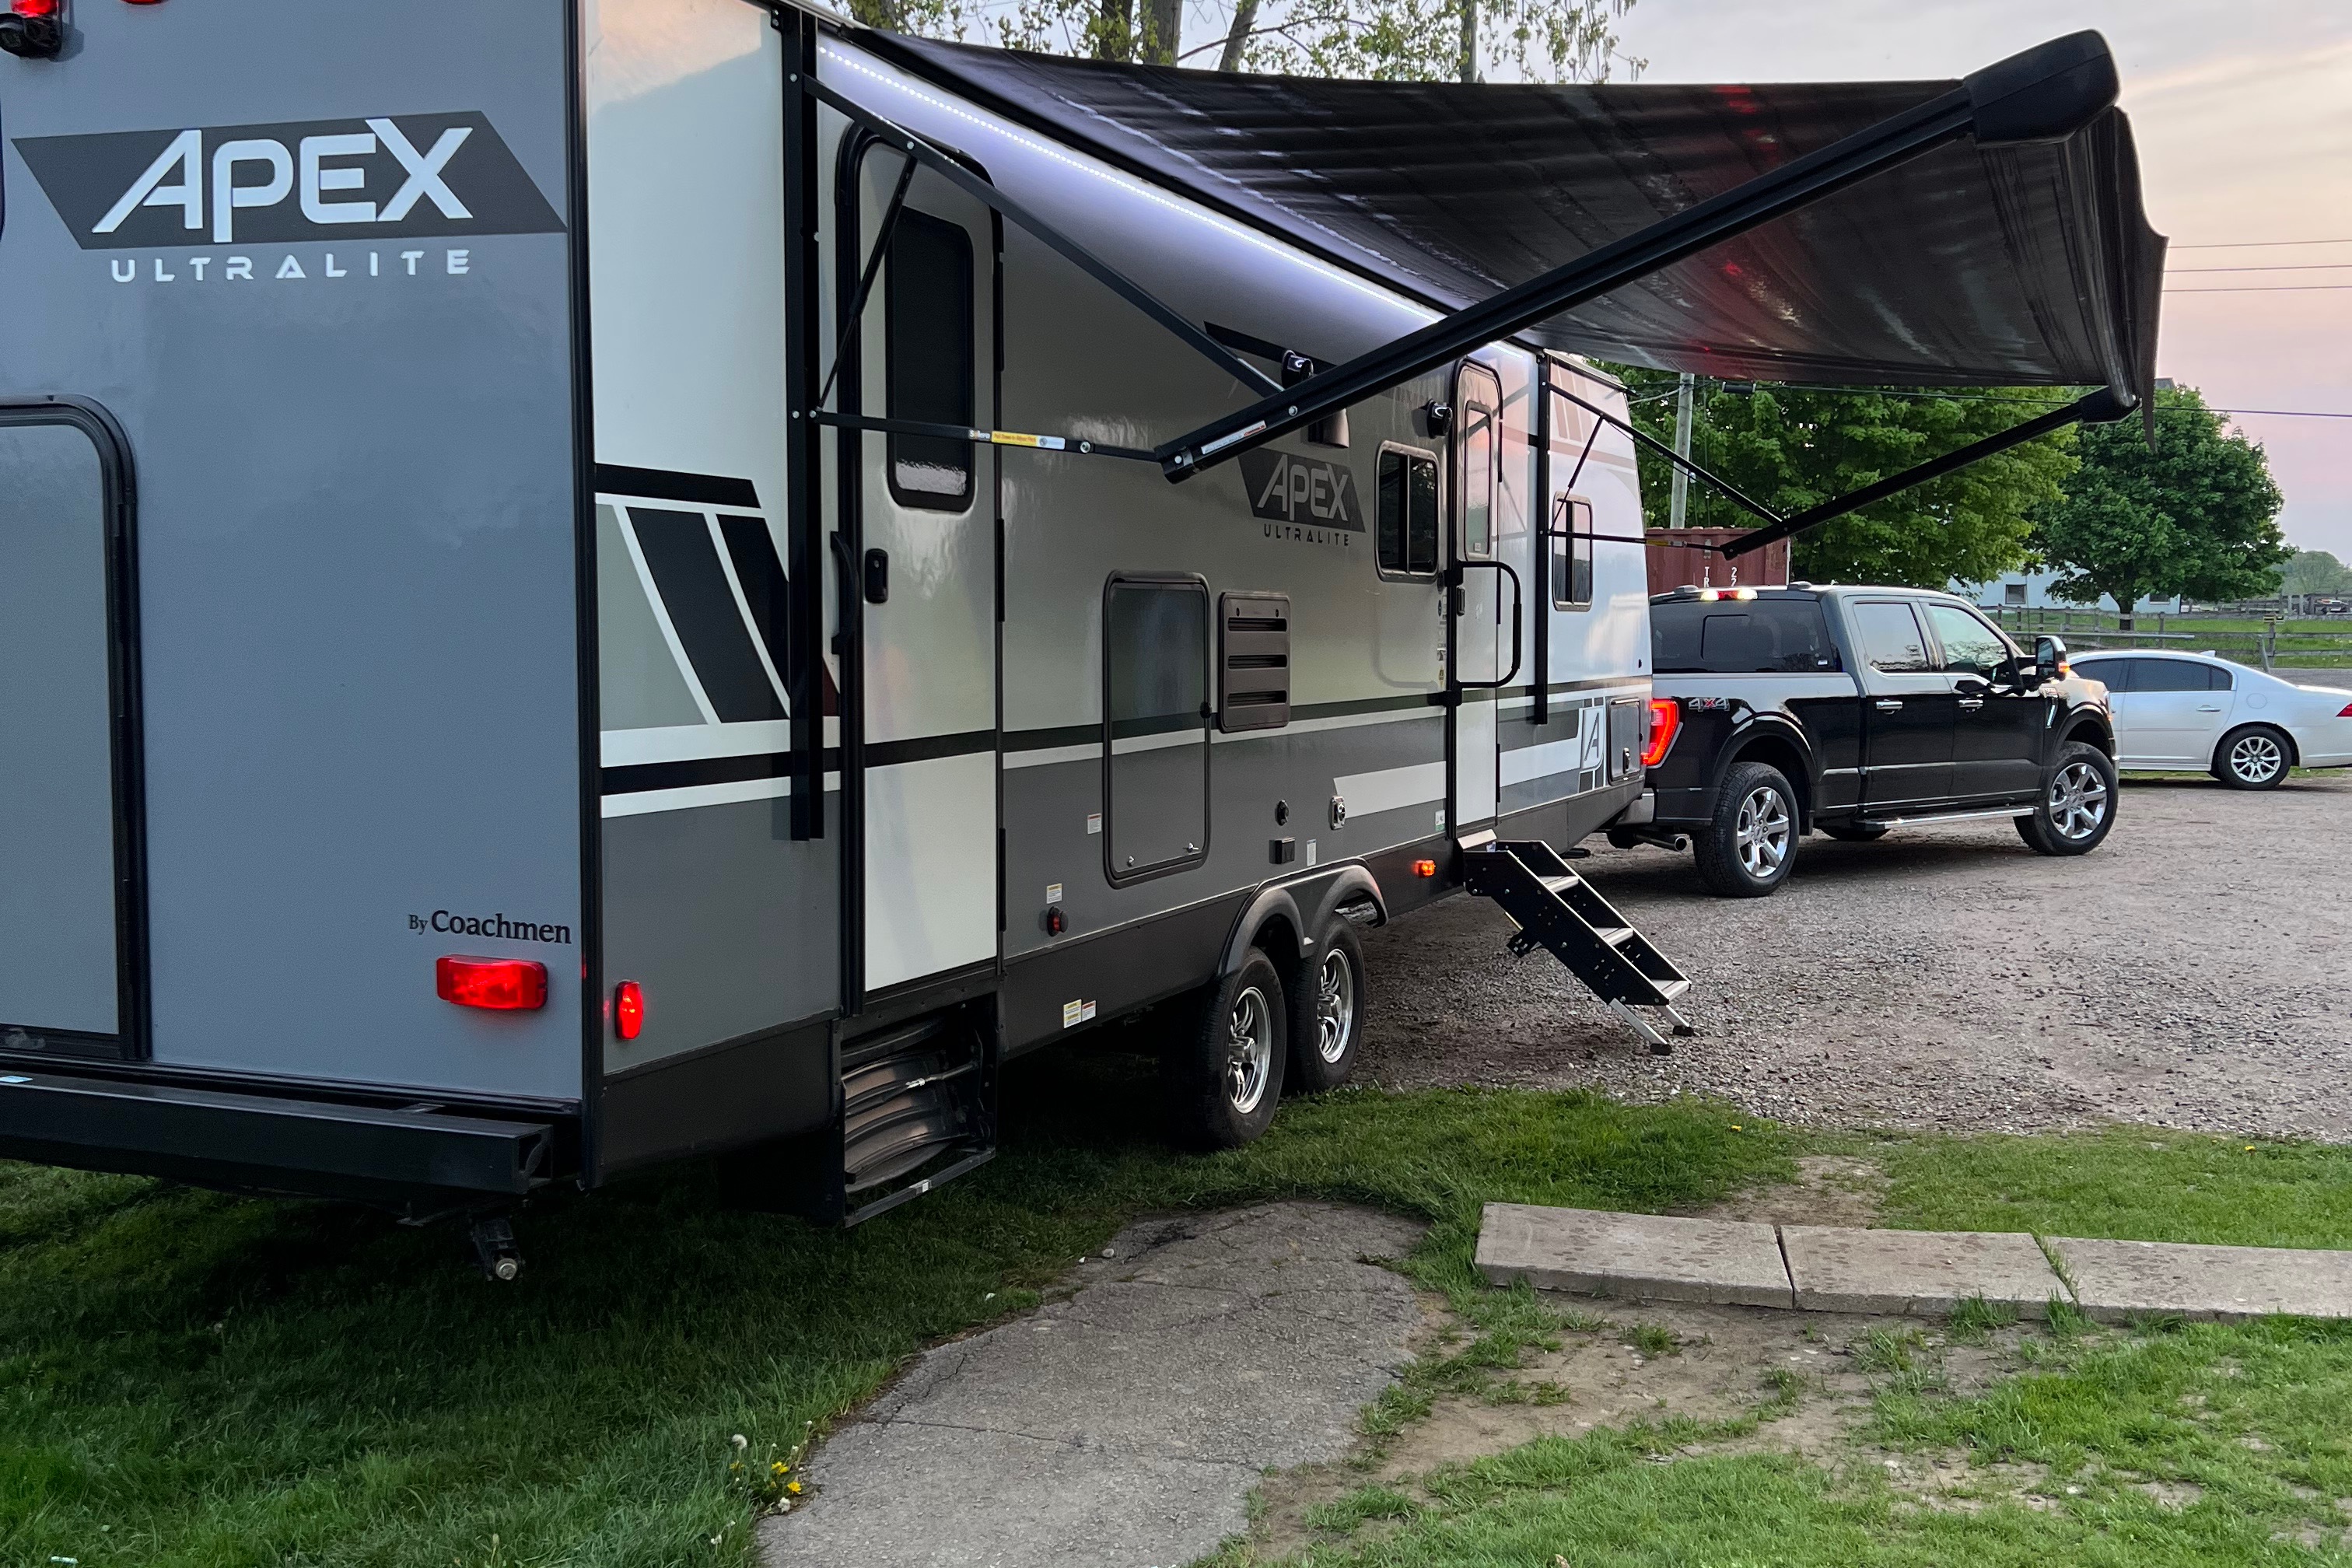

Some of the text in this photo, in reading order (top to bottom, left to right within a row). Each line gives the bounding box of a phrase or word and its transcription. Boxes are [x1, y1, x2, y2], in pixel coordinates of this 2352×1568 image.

[92, 117, 474, 243] APEX
[111, 249, 471, 282] ULTRALITE
[1257, 448, 1349, 522] APEX
[1264, 523, 1349, 546] ULTRALITE
[409, 910, 572, 943] By Coachmen
